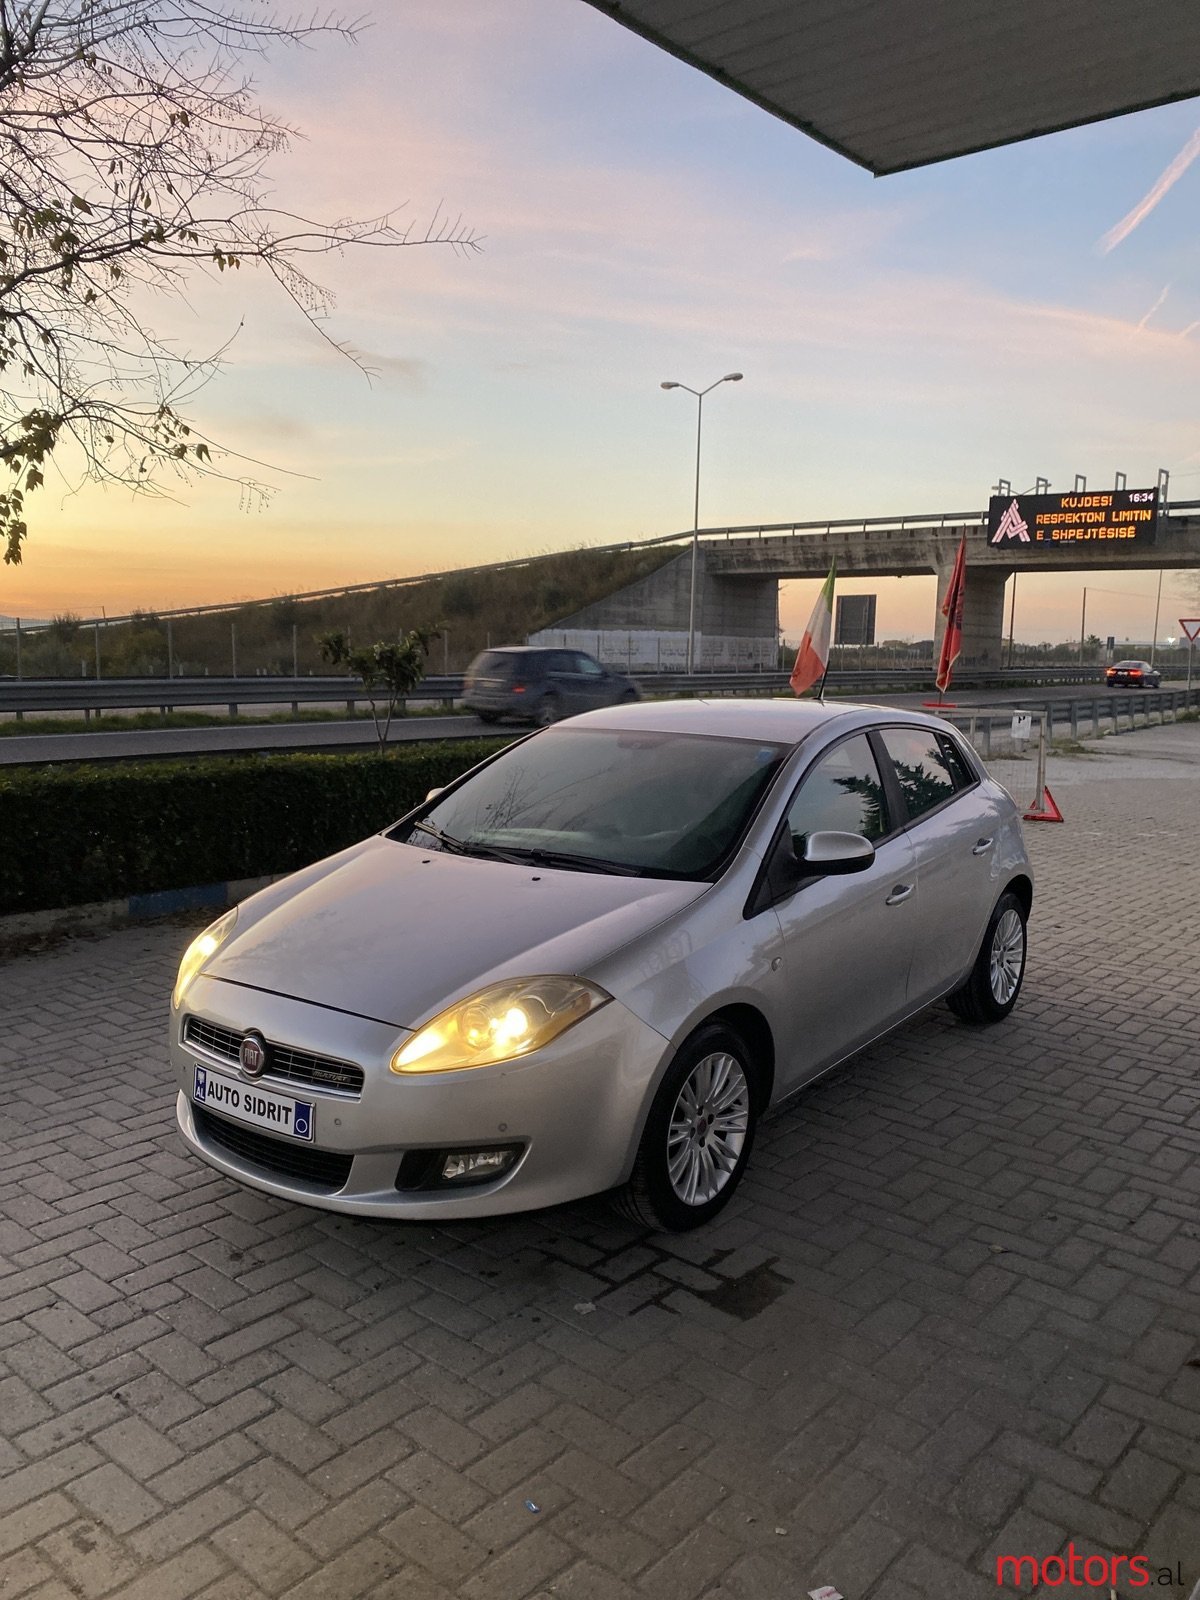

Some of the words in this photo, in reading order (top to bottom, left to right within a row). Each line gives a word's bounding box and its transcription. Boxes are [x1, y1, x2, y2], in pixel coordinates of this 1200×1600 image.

[1061, 495, 1113, 508] KUJDES!
[1128, 492, 1154, 503] 16:34
[1036, 512, 1105, 525] RESPEKTONI
[1112, 509, 1152, 522] LIMITIN
[1036, 530, 1044, 541] E
[1052, 525, 1136, 540] SHPEJTËSISË
[244, 1047, 259, 1066] FIAT
[195, 1086, 205, 1100] AL
[207, 1080, 240, 1108] AUTO
[243, 1093, 293, 1125] SIDRIT
